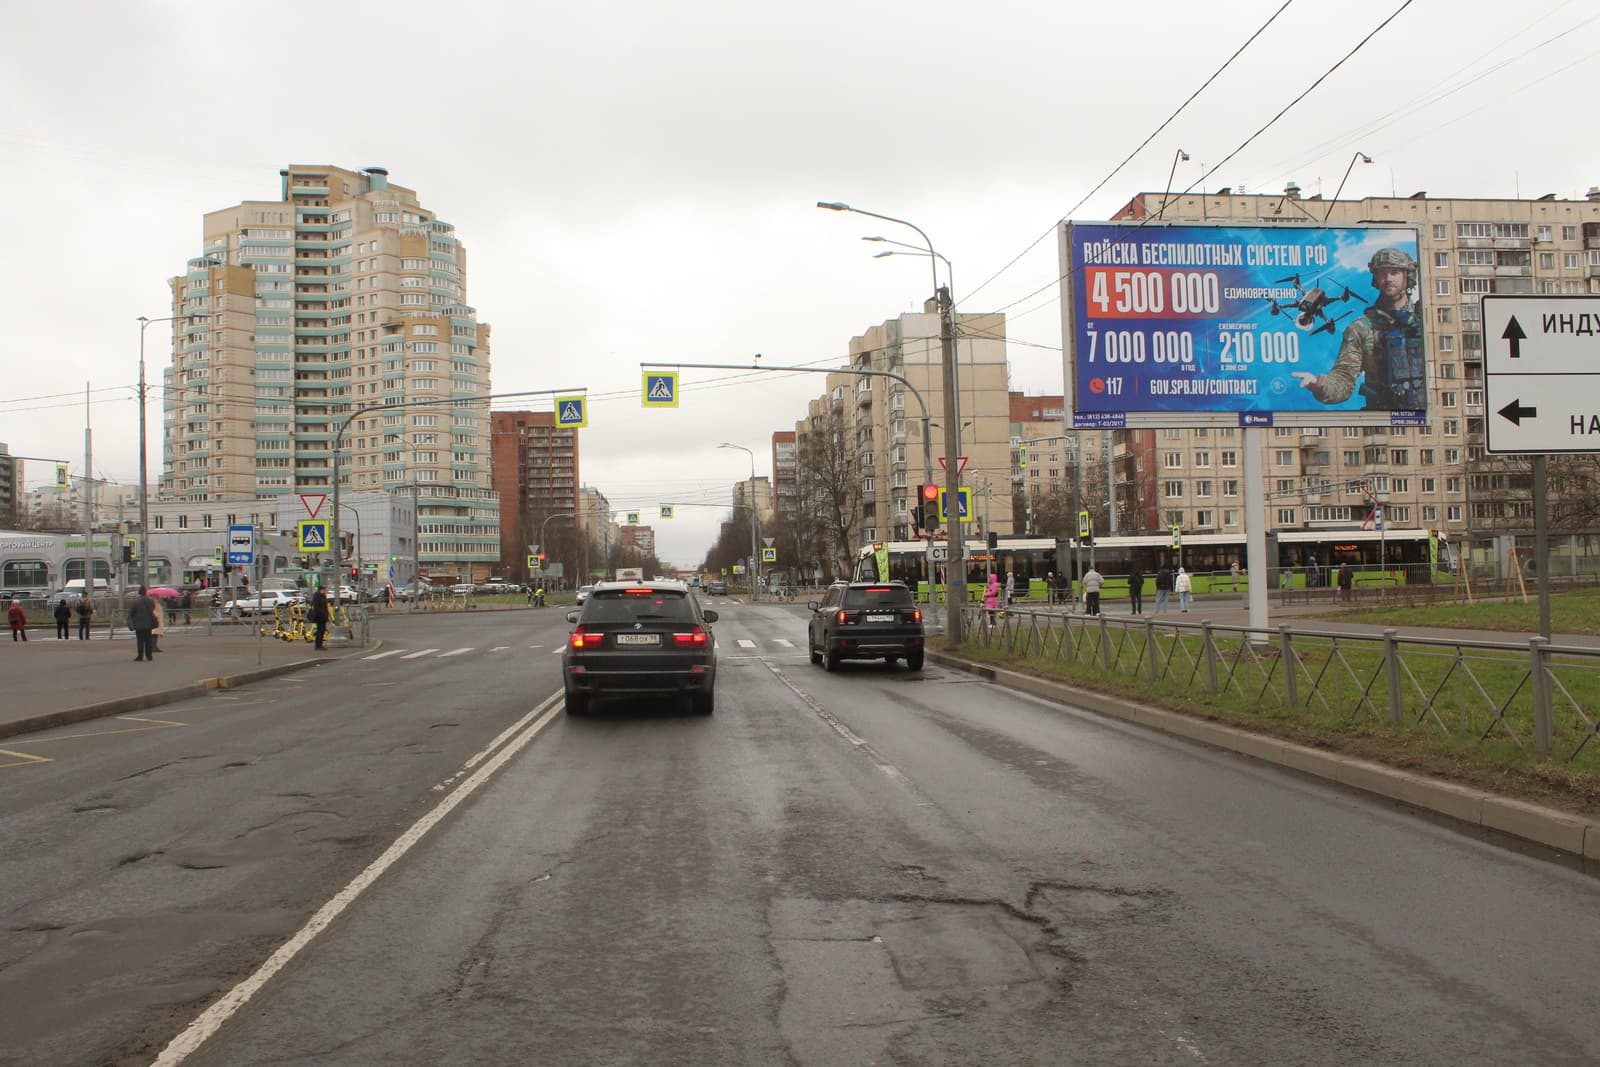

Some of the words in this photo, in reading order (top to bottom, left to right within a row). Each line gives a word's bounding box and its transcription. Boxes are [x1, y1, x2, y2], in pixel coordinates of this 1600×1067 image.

[1084, 239, 1138, 265] ВОЙСКА
[1142, 243, 1243, 266] БЕСПИЛОТНЫХ
[1247, 244, 1301, 266] СИСТЕМ
[1306, 244, 1328, 266] РФ
[1092, 271, 1110, 313] 4
[1115, 272, 1165, 314] 500
[1171, 272, 1220, 314] 000
[1224, 287, 1297, 300] ЕДИНОВРЕМЕННО
[1086, 330, 1098, 363] 7
[1104, 330, 1146, 363] 000
[1152, 331, 1193, 363] 000
[1219, 331, 1254, 363] 210
[1260, 331, 1299, 363] 000
[1106, 377, 1123, 395] 117
[1150, 379, 1257, 396] GOV.SPB.RU/CONTRACT
[1570, 414, 1600, 435] НА
[932, 548, 964, 559] СТ
